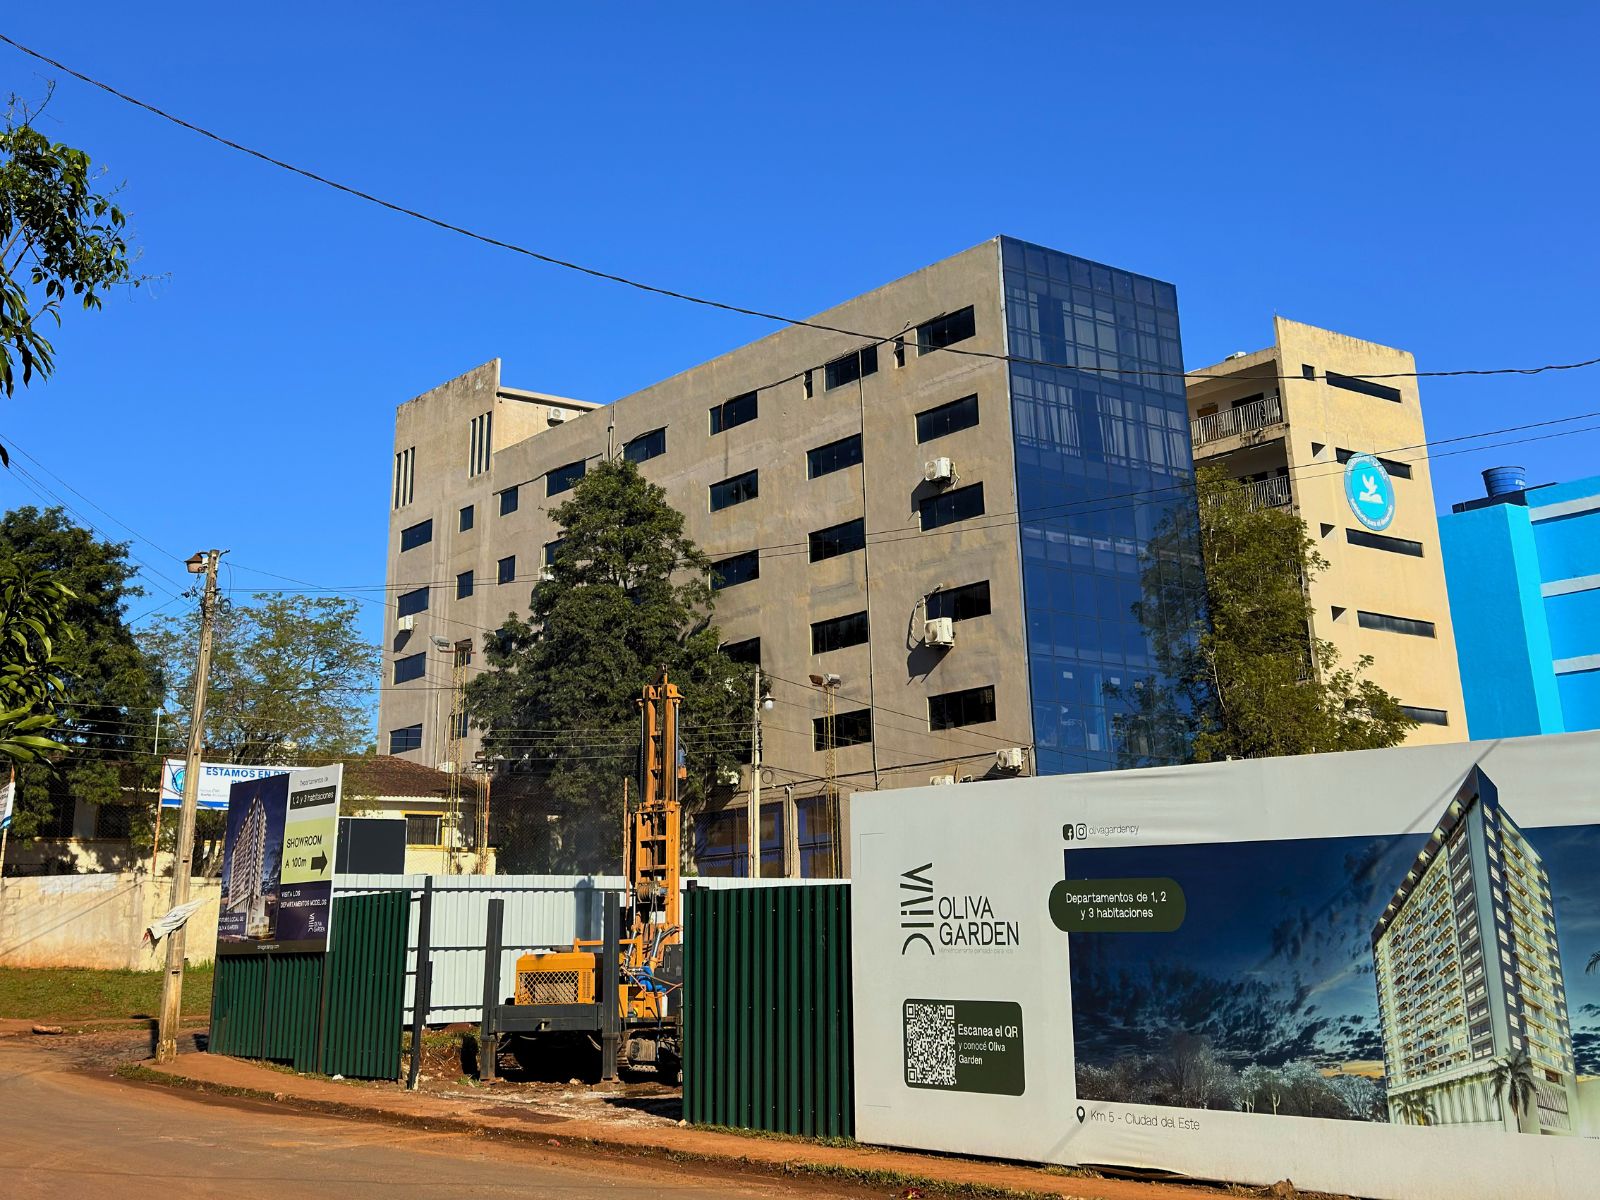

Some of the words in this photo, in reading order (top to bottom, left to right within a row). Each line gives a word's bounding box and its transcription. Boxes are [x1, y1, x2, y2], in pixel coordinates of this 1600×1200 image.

[206, 767, 255, 778] ESTAMOS
[258, 770, 270, 779] EN
[300, 796, 303, 804] y
[307, 792, 334, 802] habitaciones
[1088, 824, 1140, 836] olivagardenpy
[286, 834, 322, 848] SHOWROOM
[285, 860, 289, 868] A
[292, 857, 306, 868] 100m
[1066, 892, 1134, 904] Departamentos
[1137, 892, 1148, 902] de
[1150, 892, 1158, 903] 1,
[1160, 891, 1166, 902] 2
[280, 900, 310, 908] DEPARTAMENTOS
[938, 896, 994, 920] OLIVA
[1080, 910, 1086, 920] y
[1088, 908, 1094, 918] 3
[1096, 907, 1154, 918] habitaciones
[940, 922, 1020, 946] GARDEN
[958, 1024, 993, 1037] Escanea
[995, 1026, 1002, 1037] el
[1004, 1026, 1018, 1038] QR
[958, 1042, 962, 1051] y
[964, 1041, 986, 1051] conocé
[988, 1042, 1006, 1052] Oliva
[958, 1054, 982, 1065] Garden
[1090, 1110, 1106, 1121] Km
[1108, 1112, 1114, 1122] 5
[1125, 1112, 1158, 1126] Ciudad
[1160, 1117, 1175, 1128] del
[1178, 1117, 1200, 1130] Este
